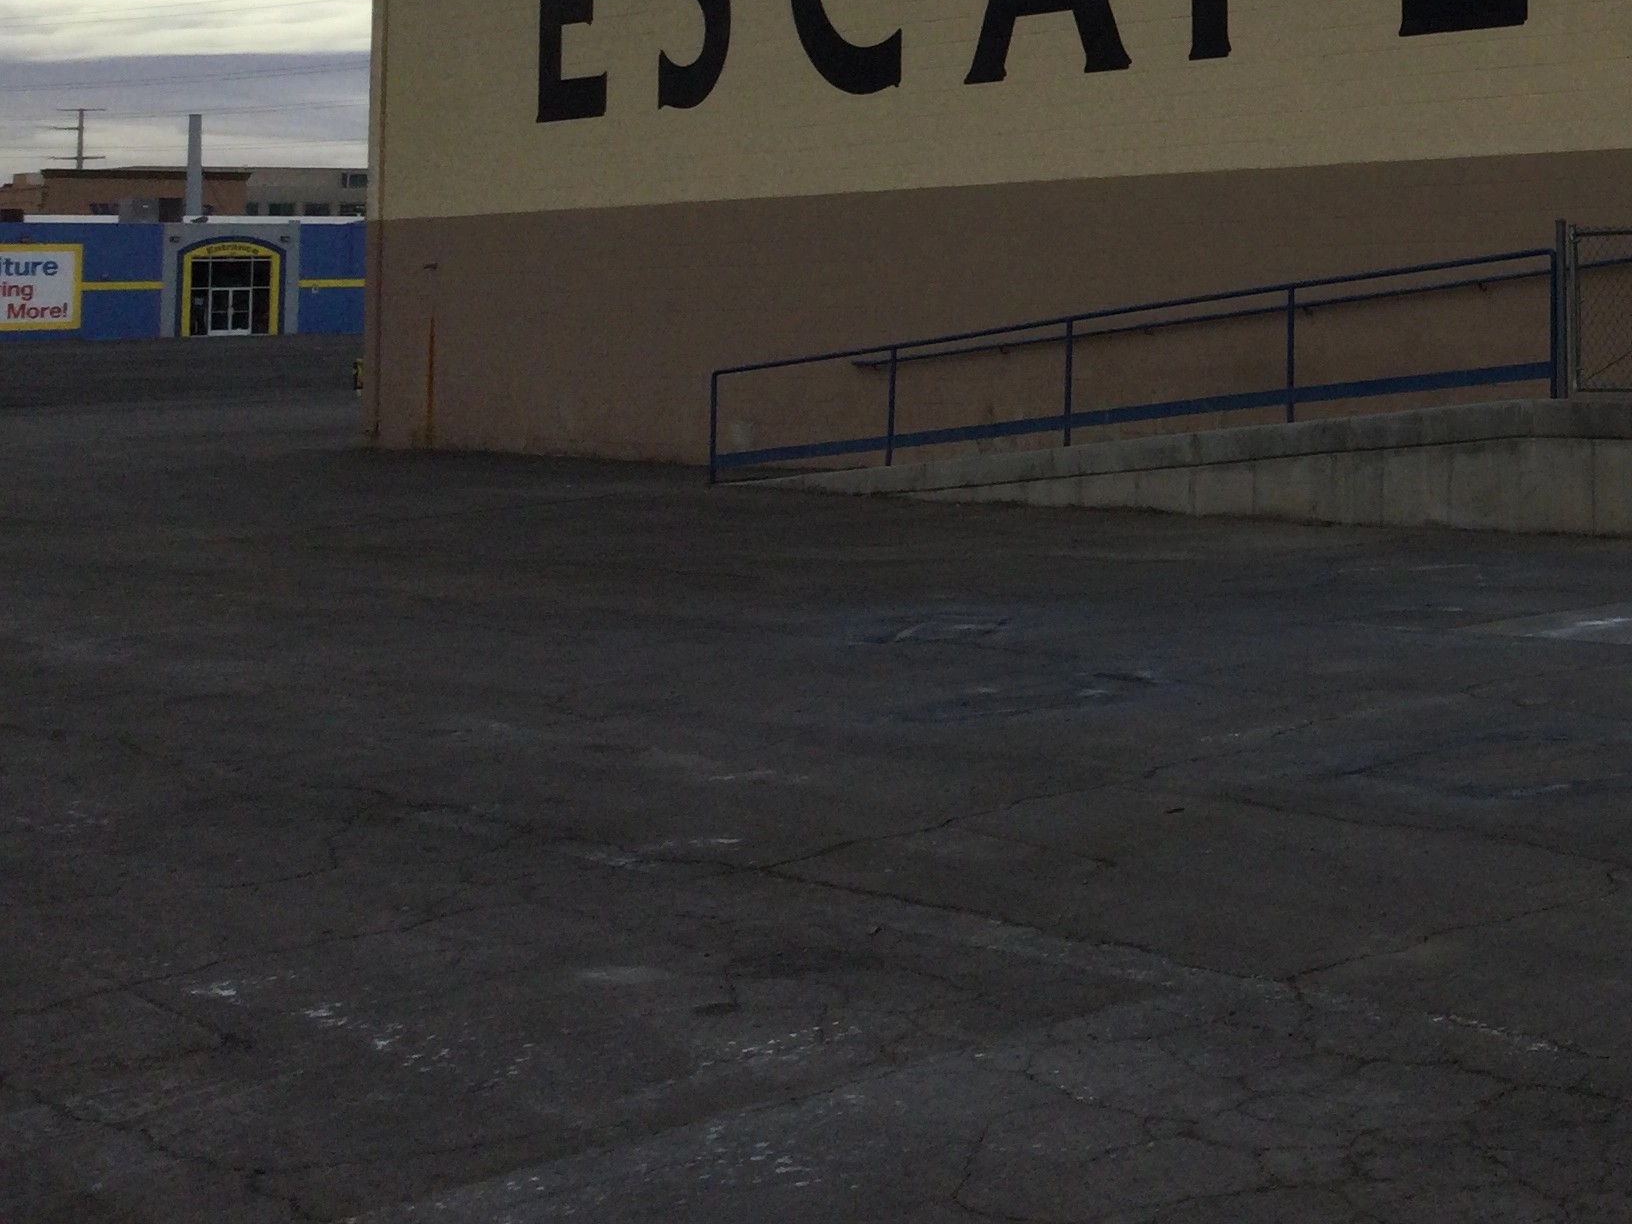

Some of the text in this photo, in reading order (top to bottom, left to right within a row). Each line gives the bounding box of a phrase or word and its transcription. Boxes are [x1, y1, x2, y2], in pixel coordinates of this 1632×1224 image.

[206, 244, 260, 255] Entrance
[0, 281, 34, 302] ing
[7, 302, 68, 319] More!
